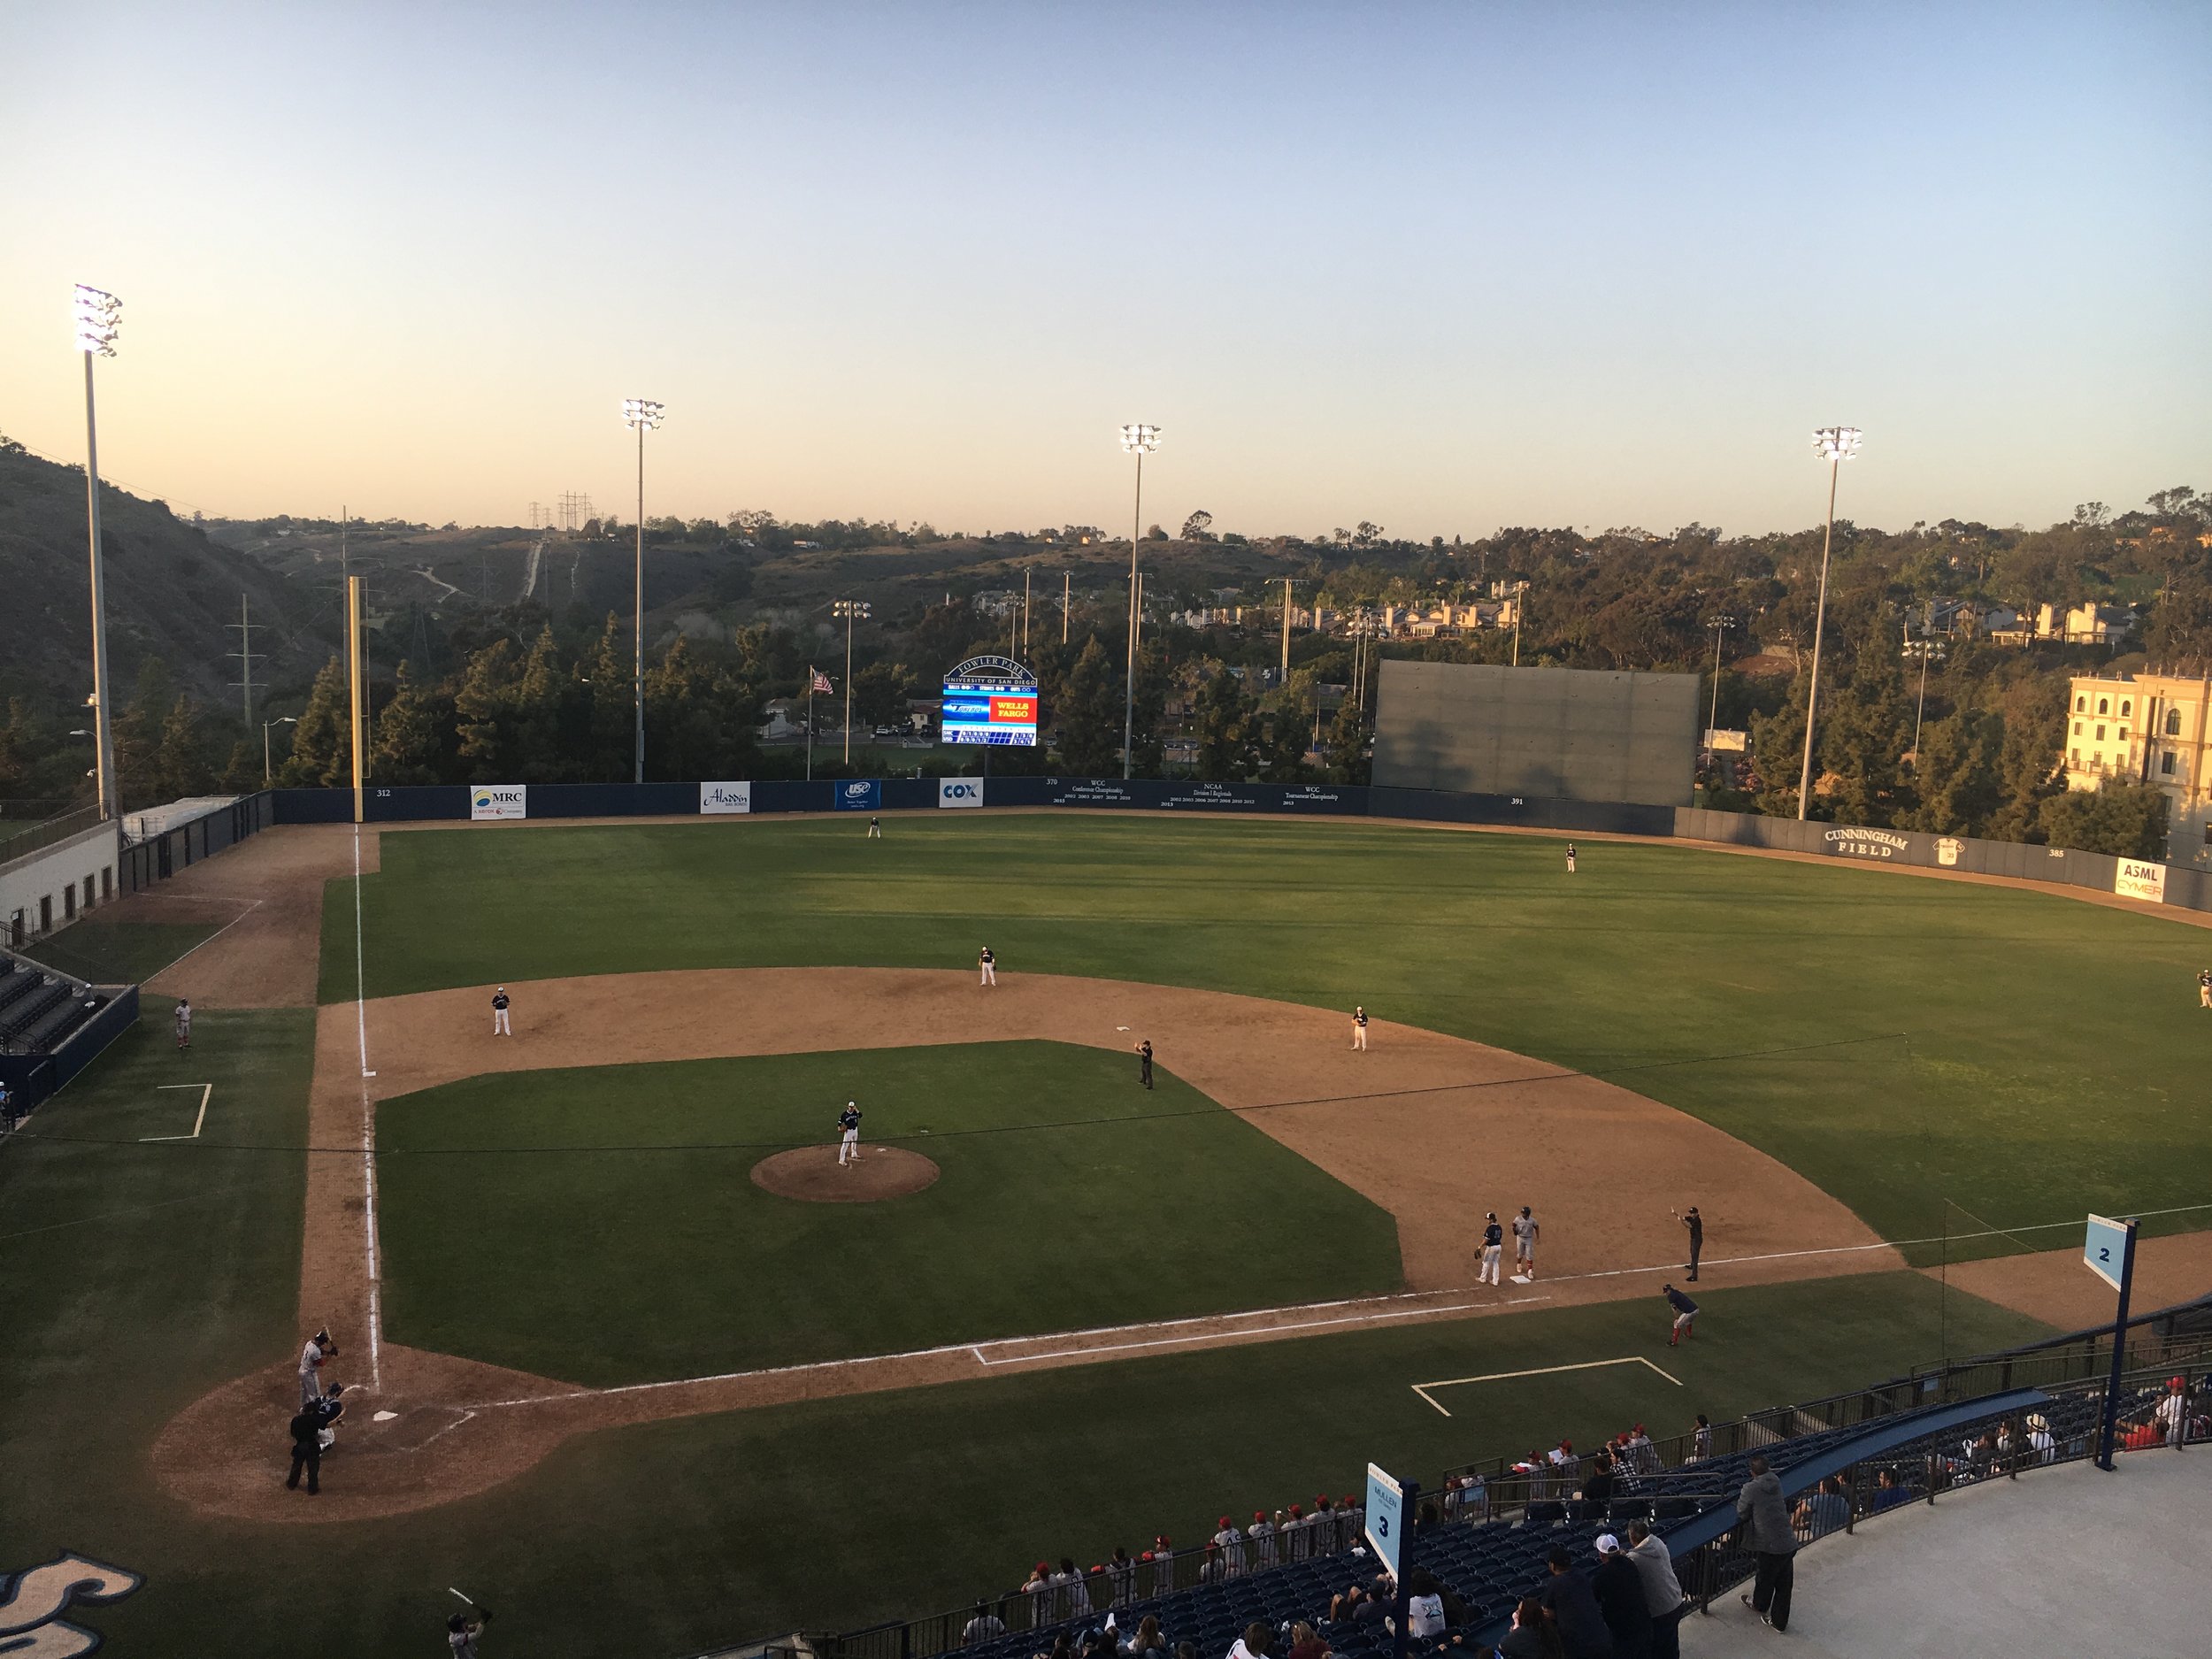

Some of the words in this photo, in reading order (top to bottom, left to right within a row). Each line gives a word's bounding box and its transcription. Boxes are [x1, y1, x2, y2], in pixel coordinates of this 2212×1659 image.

[958, 658, 998, 672] FOWLER
[1002, 660, 1025, 676] PARK
[493, 793, 522, 802] MRC
[703, 787, 748, 806] Aladdin
[943, 783, 978, 799] COX
[1824, 828, 1909, 851] CUNNINGHAM
[1839, 841, 1892, 857] FIELD
[2048, 849, 2063, 858] 385
[2124, 864, 2157, 881] ASML
[2116, 879, 2162, 896] CYMER
[2099, 1248, 2109, 1263] 2
[1374, 1486, 1397, 1508] MULLEN
[1379, 1516, 1389, 1538] 3
